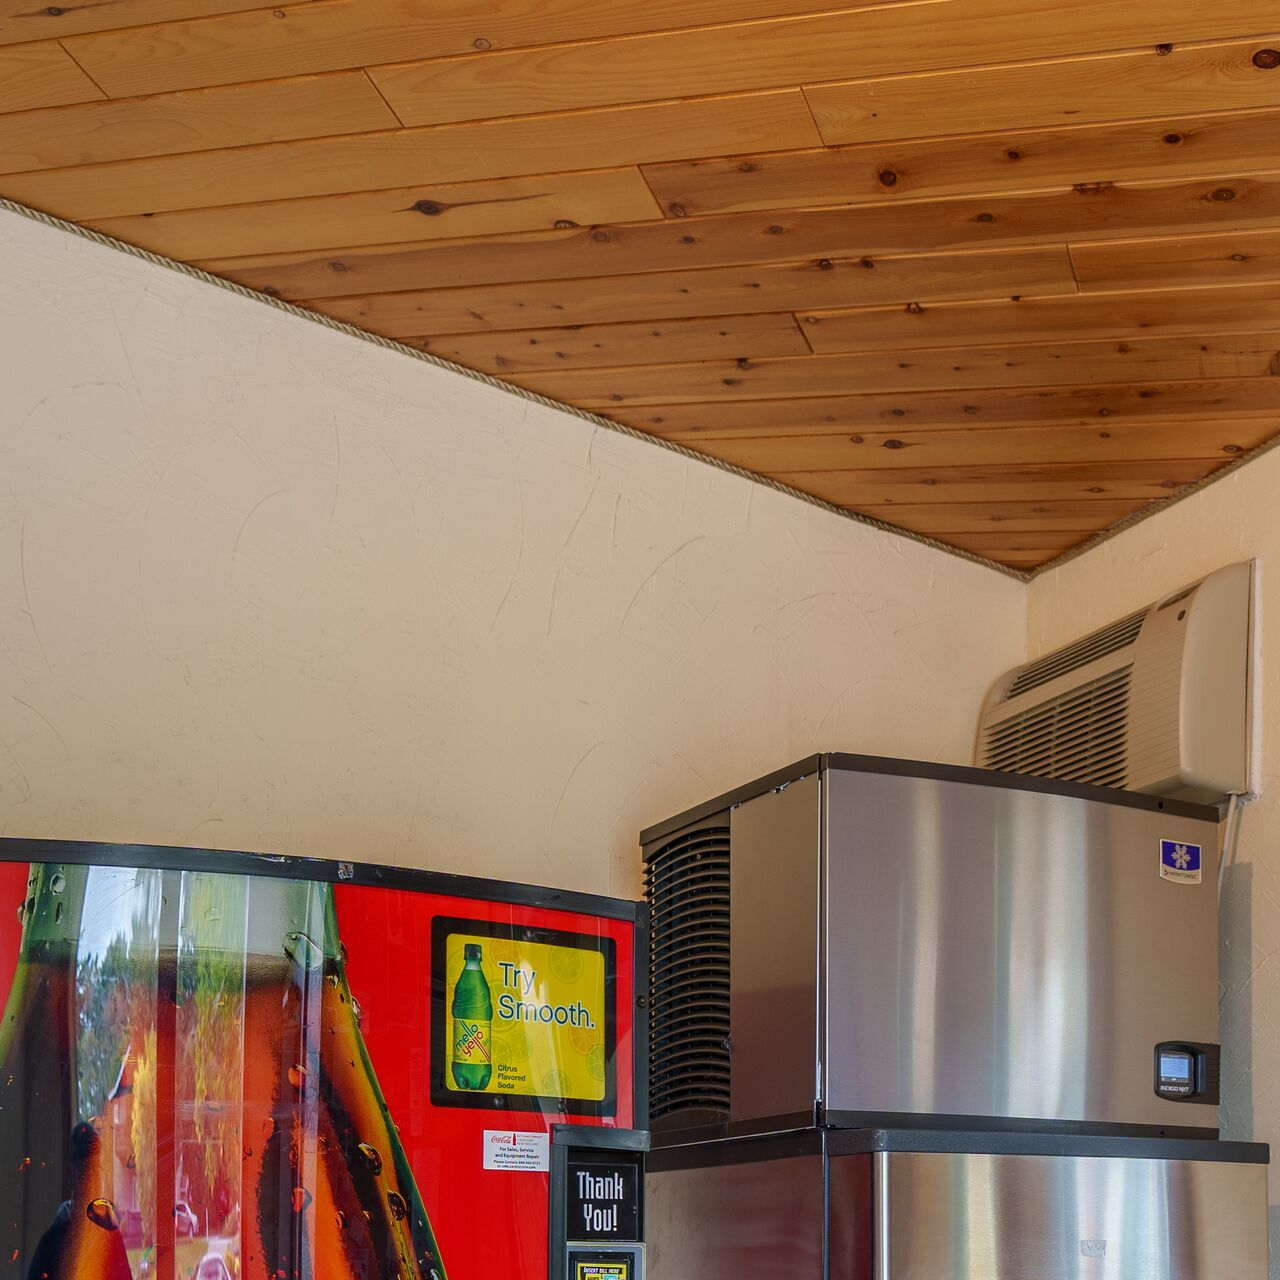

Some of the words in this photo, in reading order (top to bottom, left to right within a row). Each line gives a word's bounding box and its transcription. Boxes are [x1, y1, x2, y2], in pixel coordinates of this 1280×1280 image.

[498, 962, 536, 995] Try
[498, 994, 596, 1028] Smooth.
[455, 1020, 479, 1052] mello
[498, 1064, 518, 1072] Citrus
[498, 1073, 526, 1082] Flavored
[577, 1171, 624, 1200] Thank
[583, 1204, 617, 1231] You!
